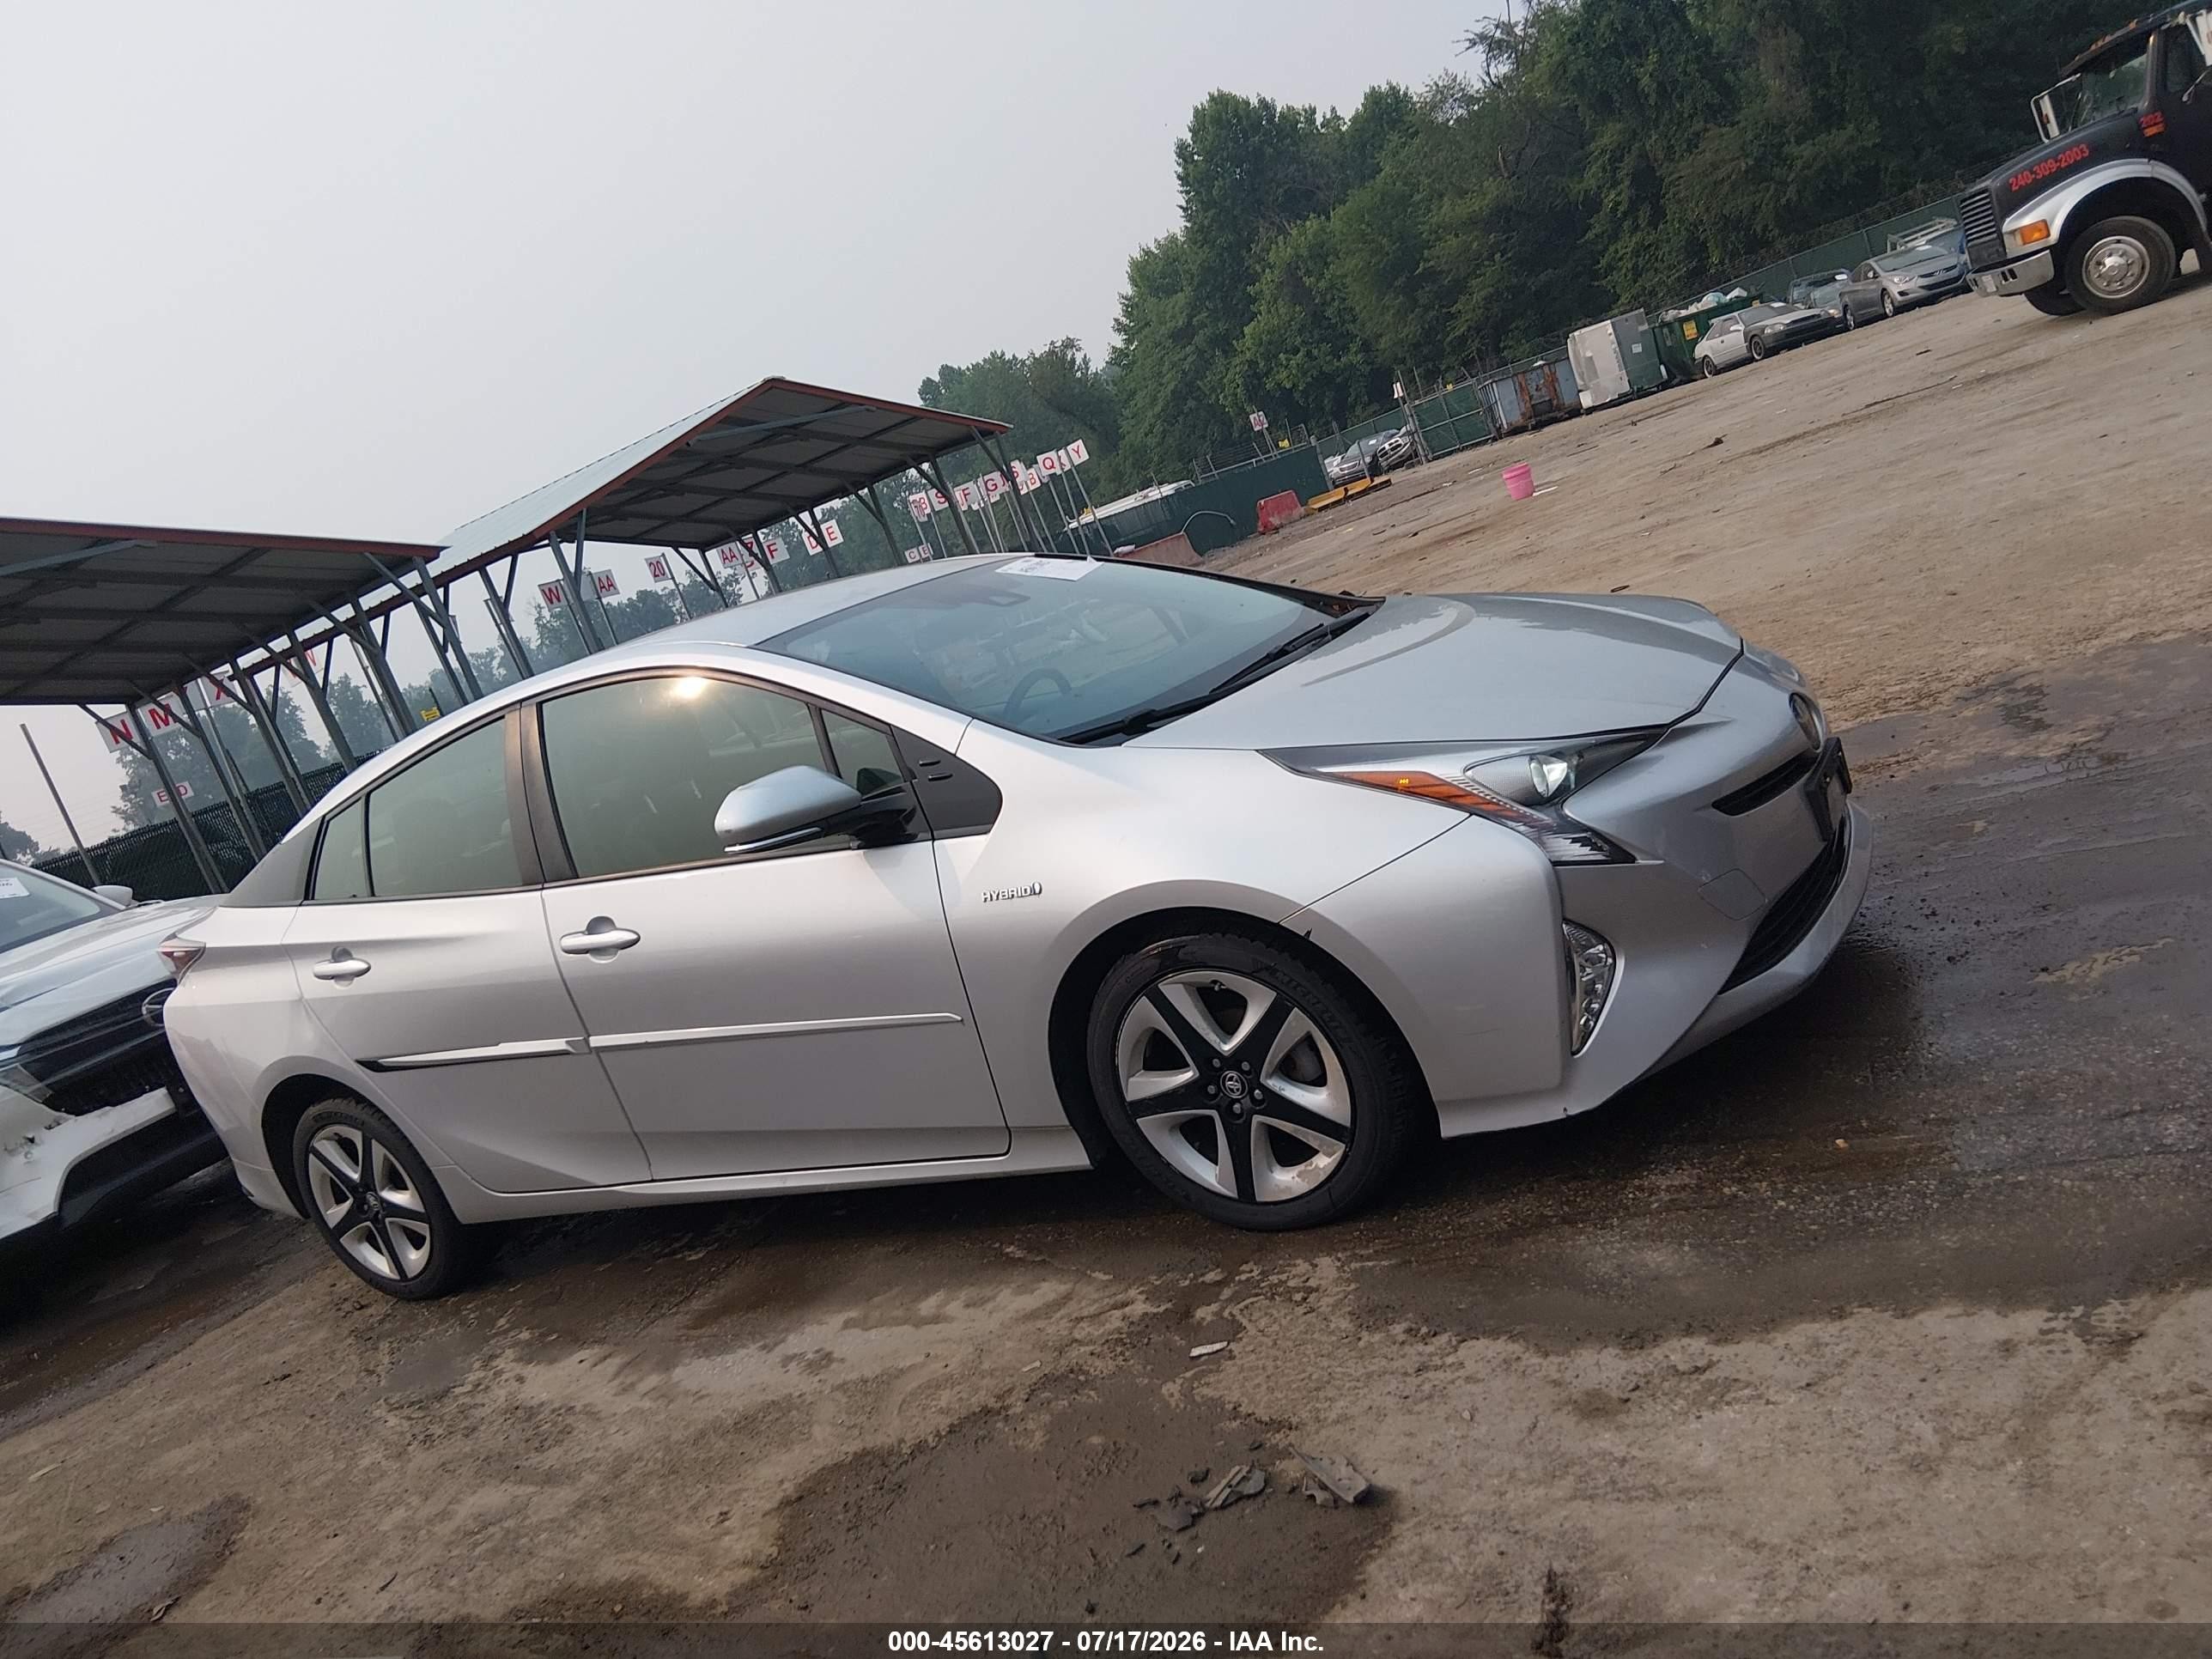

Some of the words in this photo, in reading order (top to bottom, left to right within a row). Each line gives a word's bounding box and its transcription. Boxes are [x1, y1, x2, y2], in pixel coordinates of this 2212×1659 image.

[2008, 143, 2089, 192] 240-309-2003
[1072, 445, 1081, 459] Y
[1042, 457, 1055, 470] Q
[985, 478, 998, 491] G
[962, 487, 971, 502] F
[825, 526, 838, 542] E
[720, 547, 738, 564] AA
[766, 542, 778, 560] F
[648, 561, 665, 578] 20
[597, 574, 617, 592] AA
[541, 586, 561, 605] W
[148, 702, 179, 730] M
[110, 719, 132, 745] N
[981, 884, 1032, 903] HYBRID
